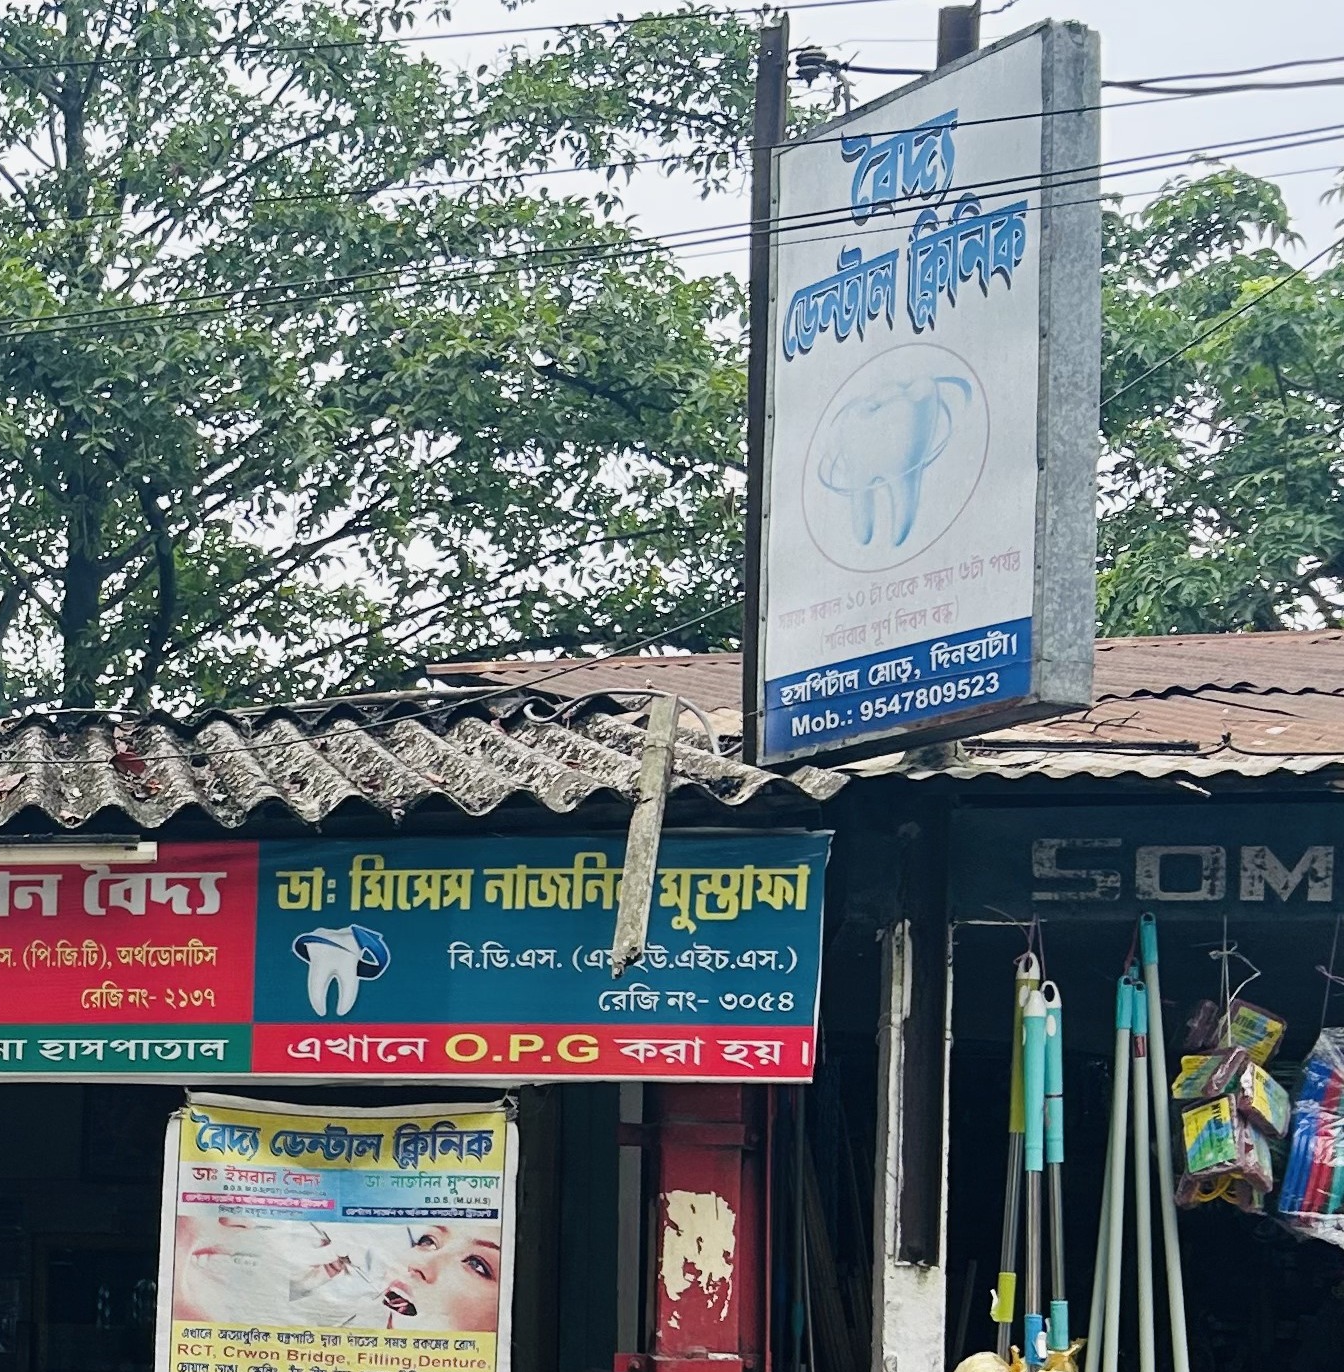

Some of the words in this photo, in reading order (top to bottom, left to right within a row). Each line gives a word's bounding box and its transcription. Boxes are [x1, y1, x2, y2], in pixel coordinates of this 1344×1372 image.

[842, 108, 958, 223] বৈদ্য
[783, 245, 899, 361] ডেন্টাল
[908, 194, 1029, 334] ক্লিনিক
[780, 668, 859, 706] হসপিটাল
[868, 656, 921, 686] মোড়,
[791, 709, 852, 736] Mob.:
[860, 672, 999, 721] 9547809523
[82, 863, 227, 916] বৈদ্য
[276, 867, 335, 911] ডাঃ
[349, 854, 473, 911] মিসেস
[658, 865, 809, 935] মুস্তাফা
[1032, 838, 1333, 902] SOM
[81, 982, 123, 1010] রেজি
[128, 989, 157, 1009] নং-
[164, 988, 215, 1009] ২১৩৭
[598, 984, 658, 1013] রেজি
[666, 990, 709, 1011] নং-
[718, 993, 794, 1012] ৩০৫৪
[38, 1037, 228, 1061] হাসপাতাল
[287, 1037, 428, 1063] এখানে
[444, 1034, 599, 1062] O.P.G
[616, 1039, 704, 1065] করা
[717, 1040, 784, 1067] হয়
[223, 1346, 280, 1362] Crwon
[287, 1348, 351, 1369] Bridge,
